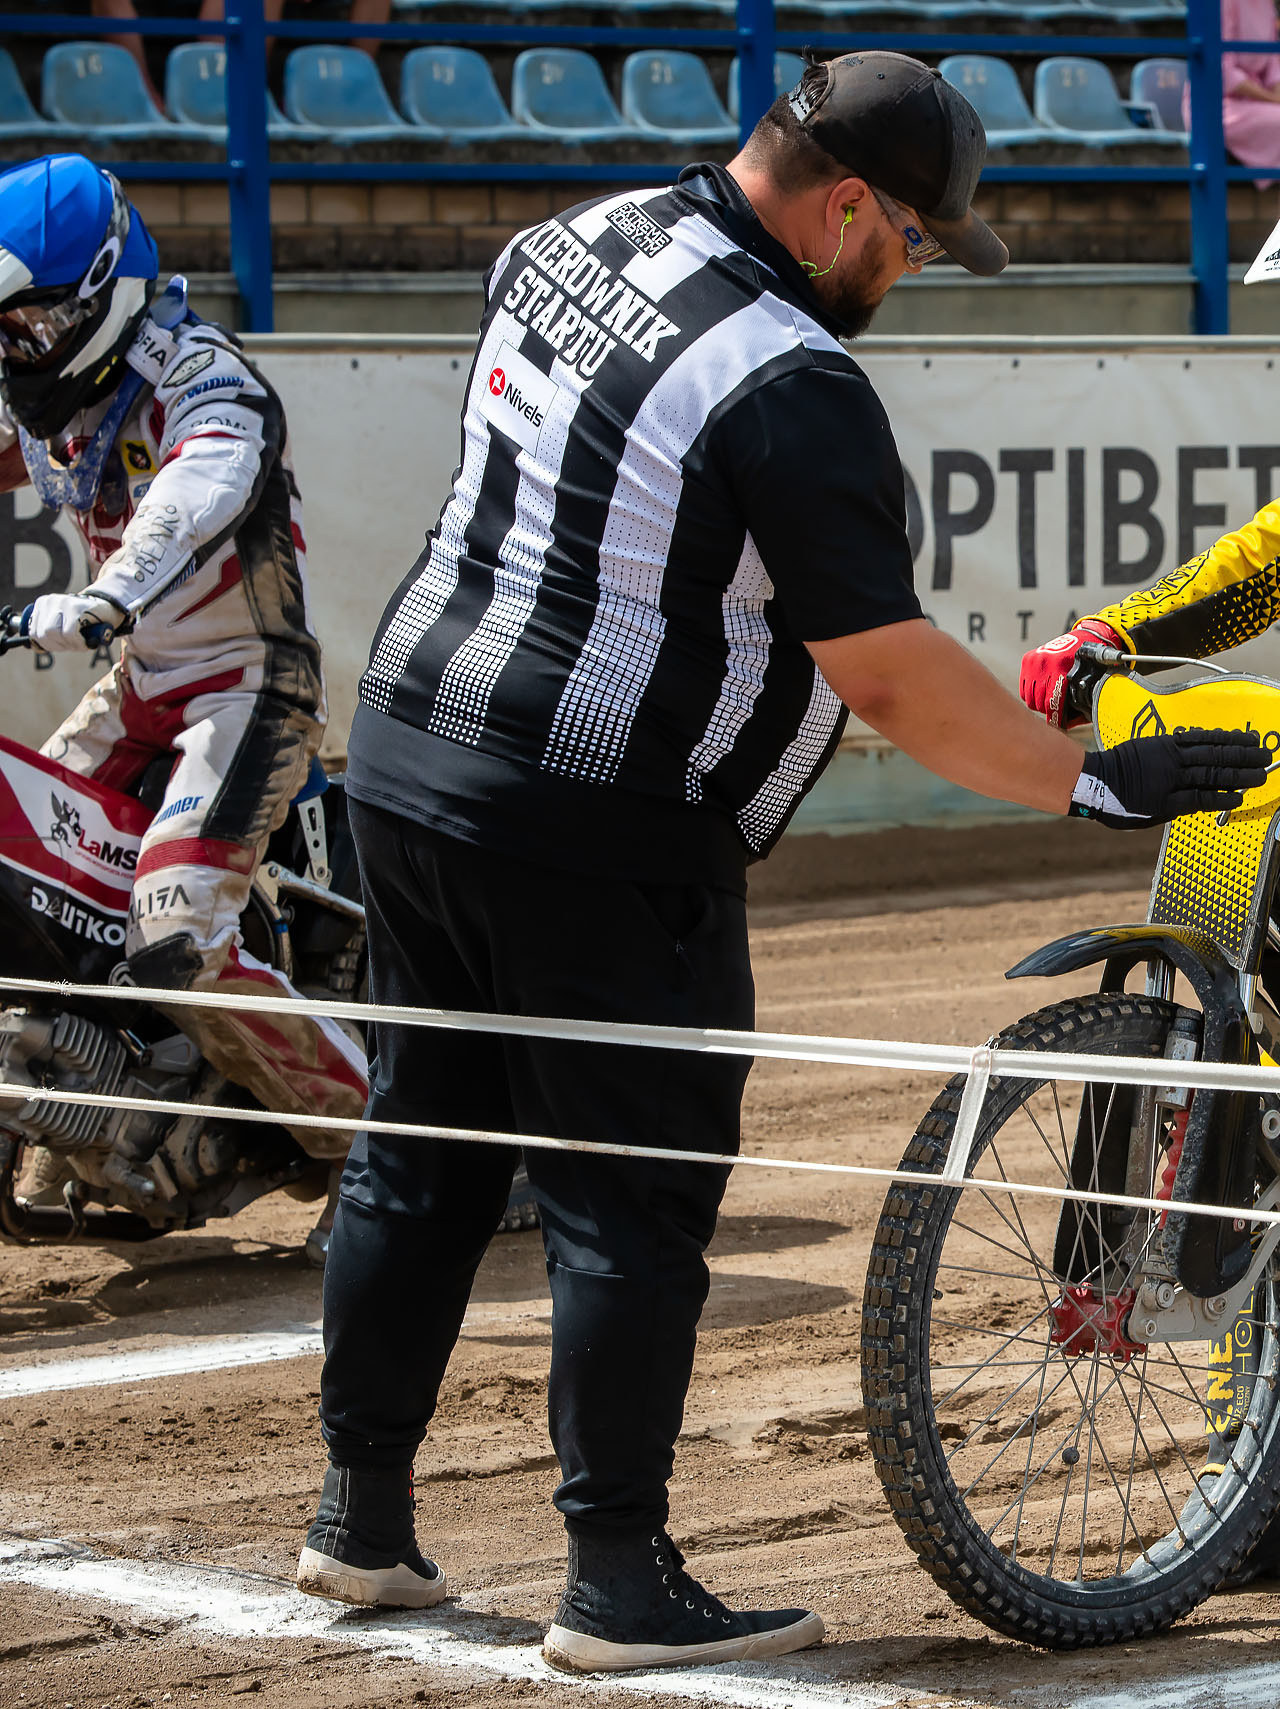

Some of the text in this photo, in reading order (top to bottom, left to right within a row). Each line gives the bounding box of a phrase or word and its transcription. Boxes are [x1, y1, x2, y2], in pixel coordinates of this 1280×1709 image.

[620, 203, 669, 248] EXTREME
[503, 265, 618, 378] STARTU
[520, 219, 682, 363] KIEROWNIK
[503, 382, 545, 428] Nivels
